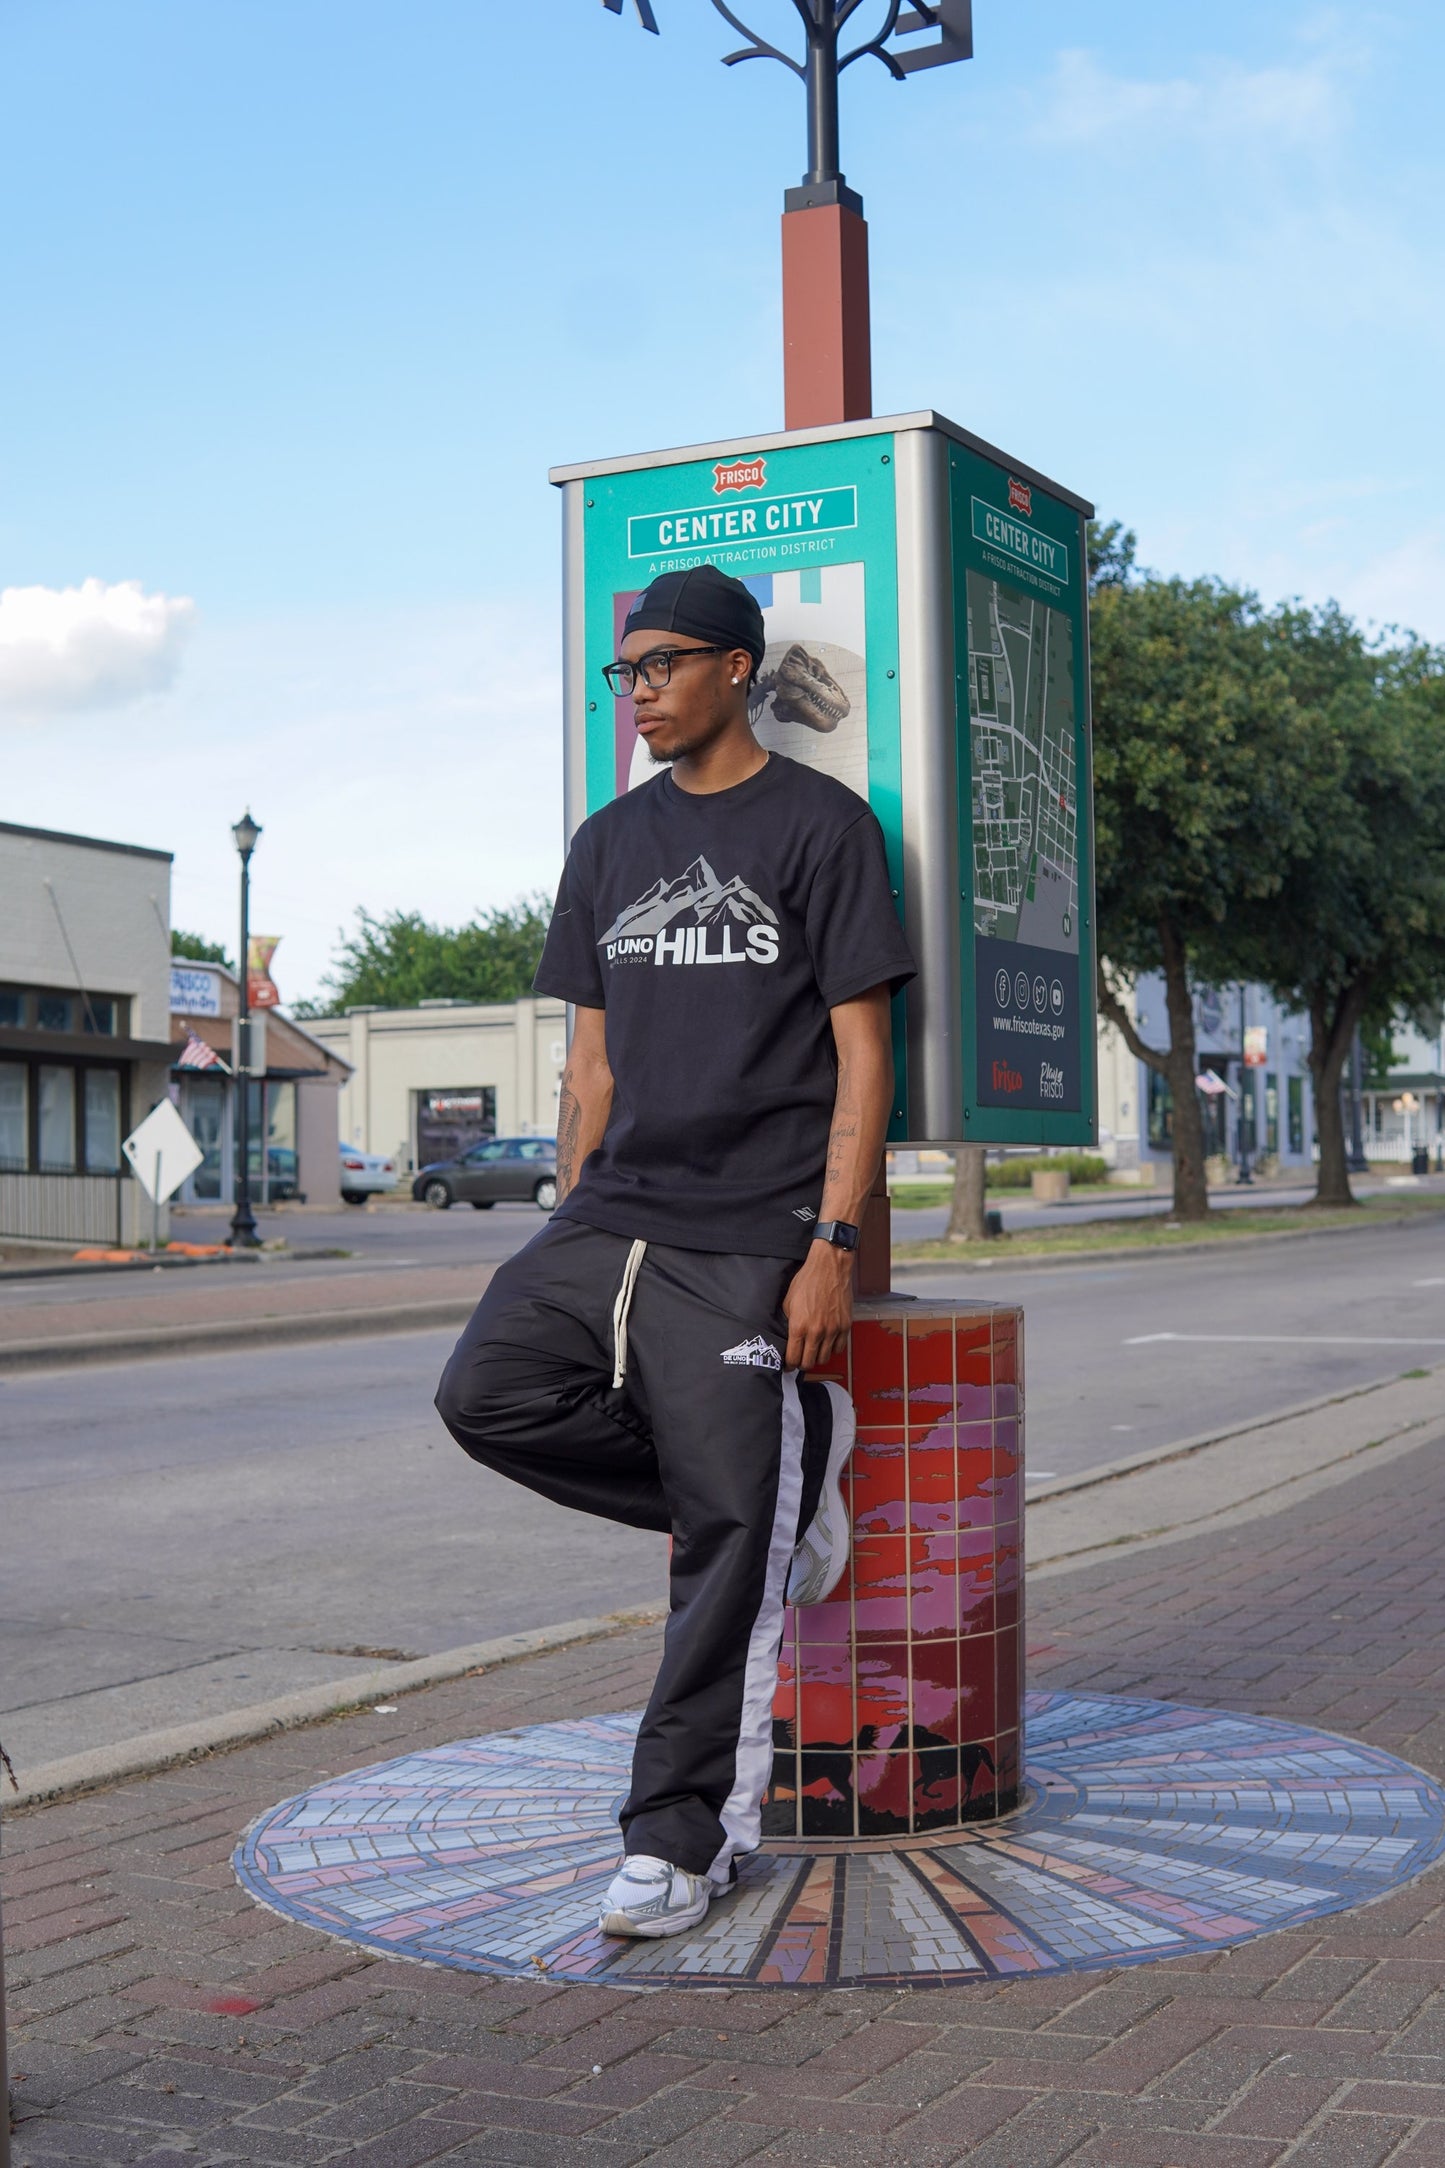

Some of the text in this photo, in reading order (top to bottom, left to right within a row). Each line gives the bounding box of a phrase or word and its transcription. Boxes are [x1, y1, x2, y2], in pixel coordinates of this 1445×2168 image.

[719, 467, 760, 485] FRISCO
[1011, 486, 1029, 507] FRISCO
[658, 498, 824, 546] CENTER CITY
[985, 512, 1055, 568] CENTER CITY
[648, 538, 836, 574] A FRISCO ATTRACTION DISTRICT
[982, 550, 1061, 598] A FRISCO ATTRACTION DISTRICT
[617, 937, 654, 955] UNO
[654, 924, 780, 966] HILLS
[629, 956, 648, 964] 2024
[992, 1015, 1065, 1041] www.friscotexas.gov
[1040, 1080, 1064, 1099] FRISCO
[746, 1354, 781, 1371] HILLS
